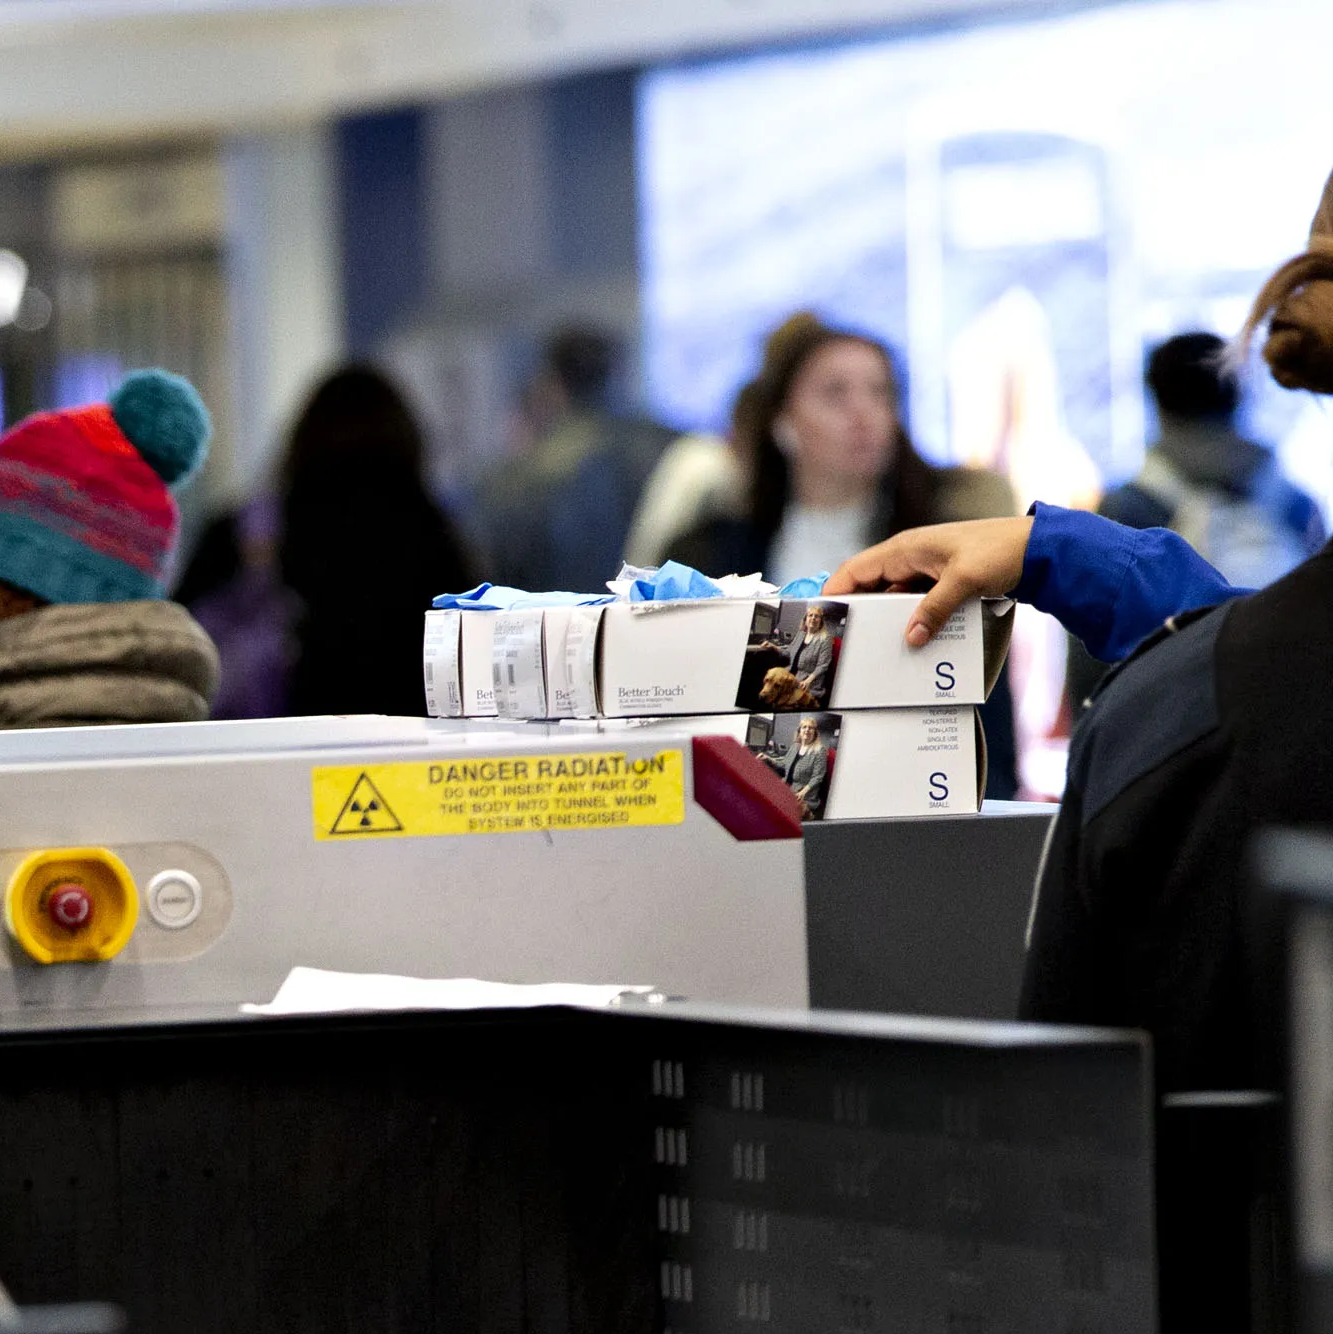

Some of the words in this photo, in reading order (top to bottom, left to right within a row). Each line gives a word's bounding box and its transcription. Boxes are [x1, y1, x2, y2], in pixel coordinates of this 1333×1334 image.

[935, 661, 955, 690] S
[618, 687, 650, 698] Better
[652, 685, 684, 697] Touch
[922, 717, 957, 725] NON-STERILE
[428, 761, 528, 785] DANGER
[444, 787, 463, 798] DO
[469, 785, 496, 797] NOT
[503, 782, 552, 796] INSERT
[558, 781, 585, 793] ANY
[591, 779, 626, 791] PART
[633, 778, 650, 791] OF
[929, 772, 949, 801] S
[440, 803, 463, 814] THE
[472, 801, 511, 813] BODY
[517, 799, 549, 811] INTO
[555, 796, 607, 809] TUNNEL
[615, 794, 657, 806] WHEN
[468, 816, 525, 830] SYSTEM
[530, 814, 543, 827] IS
[548, 811, 630, 825] ENERGISED
